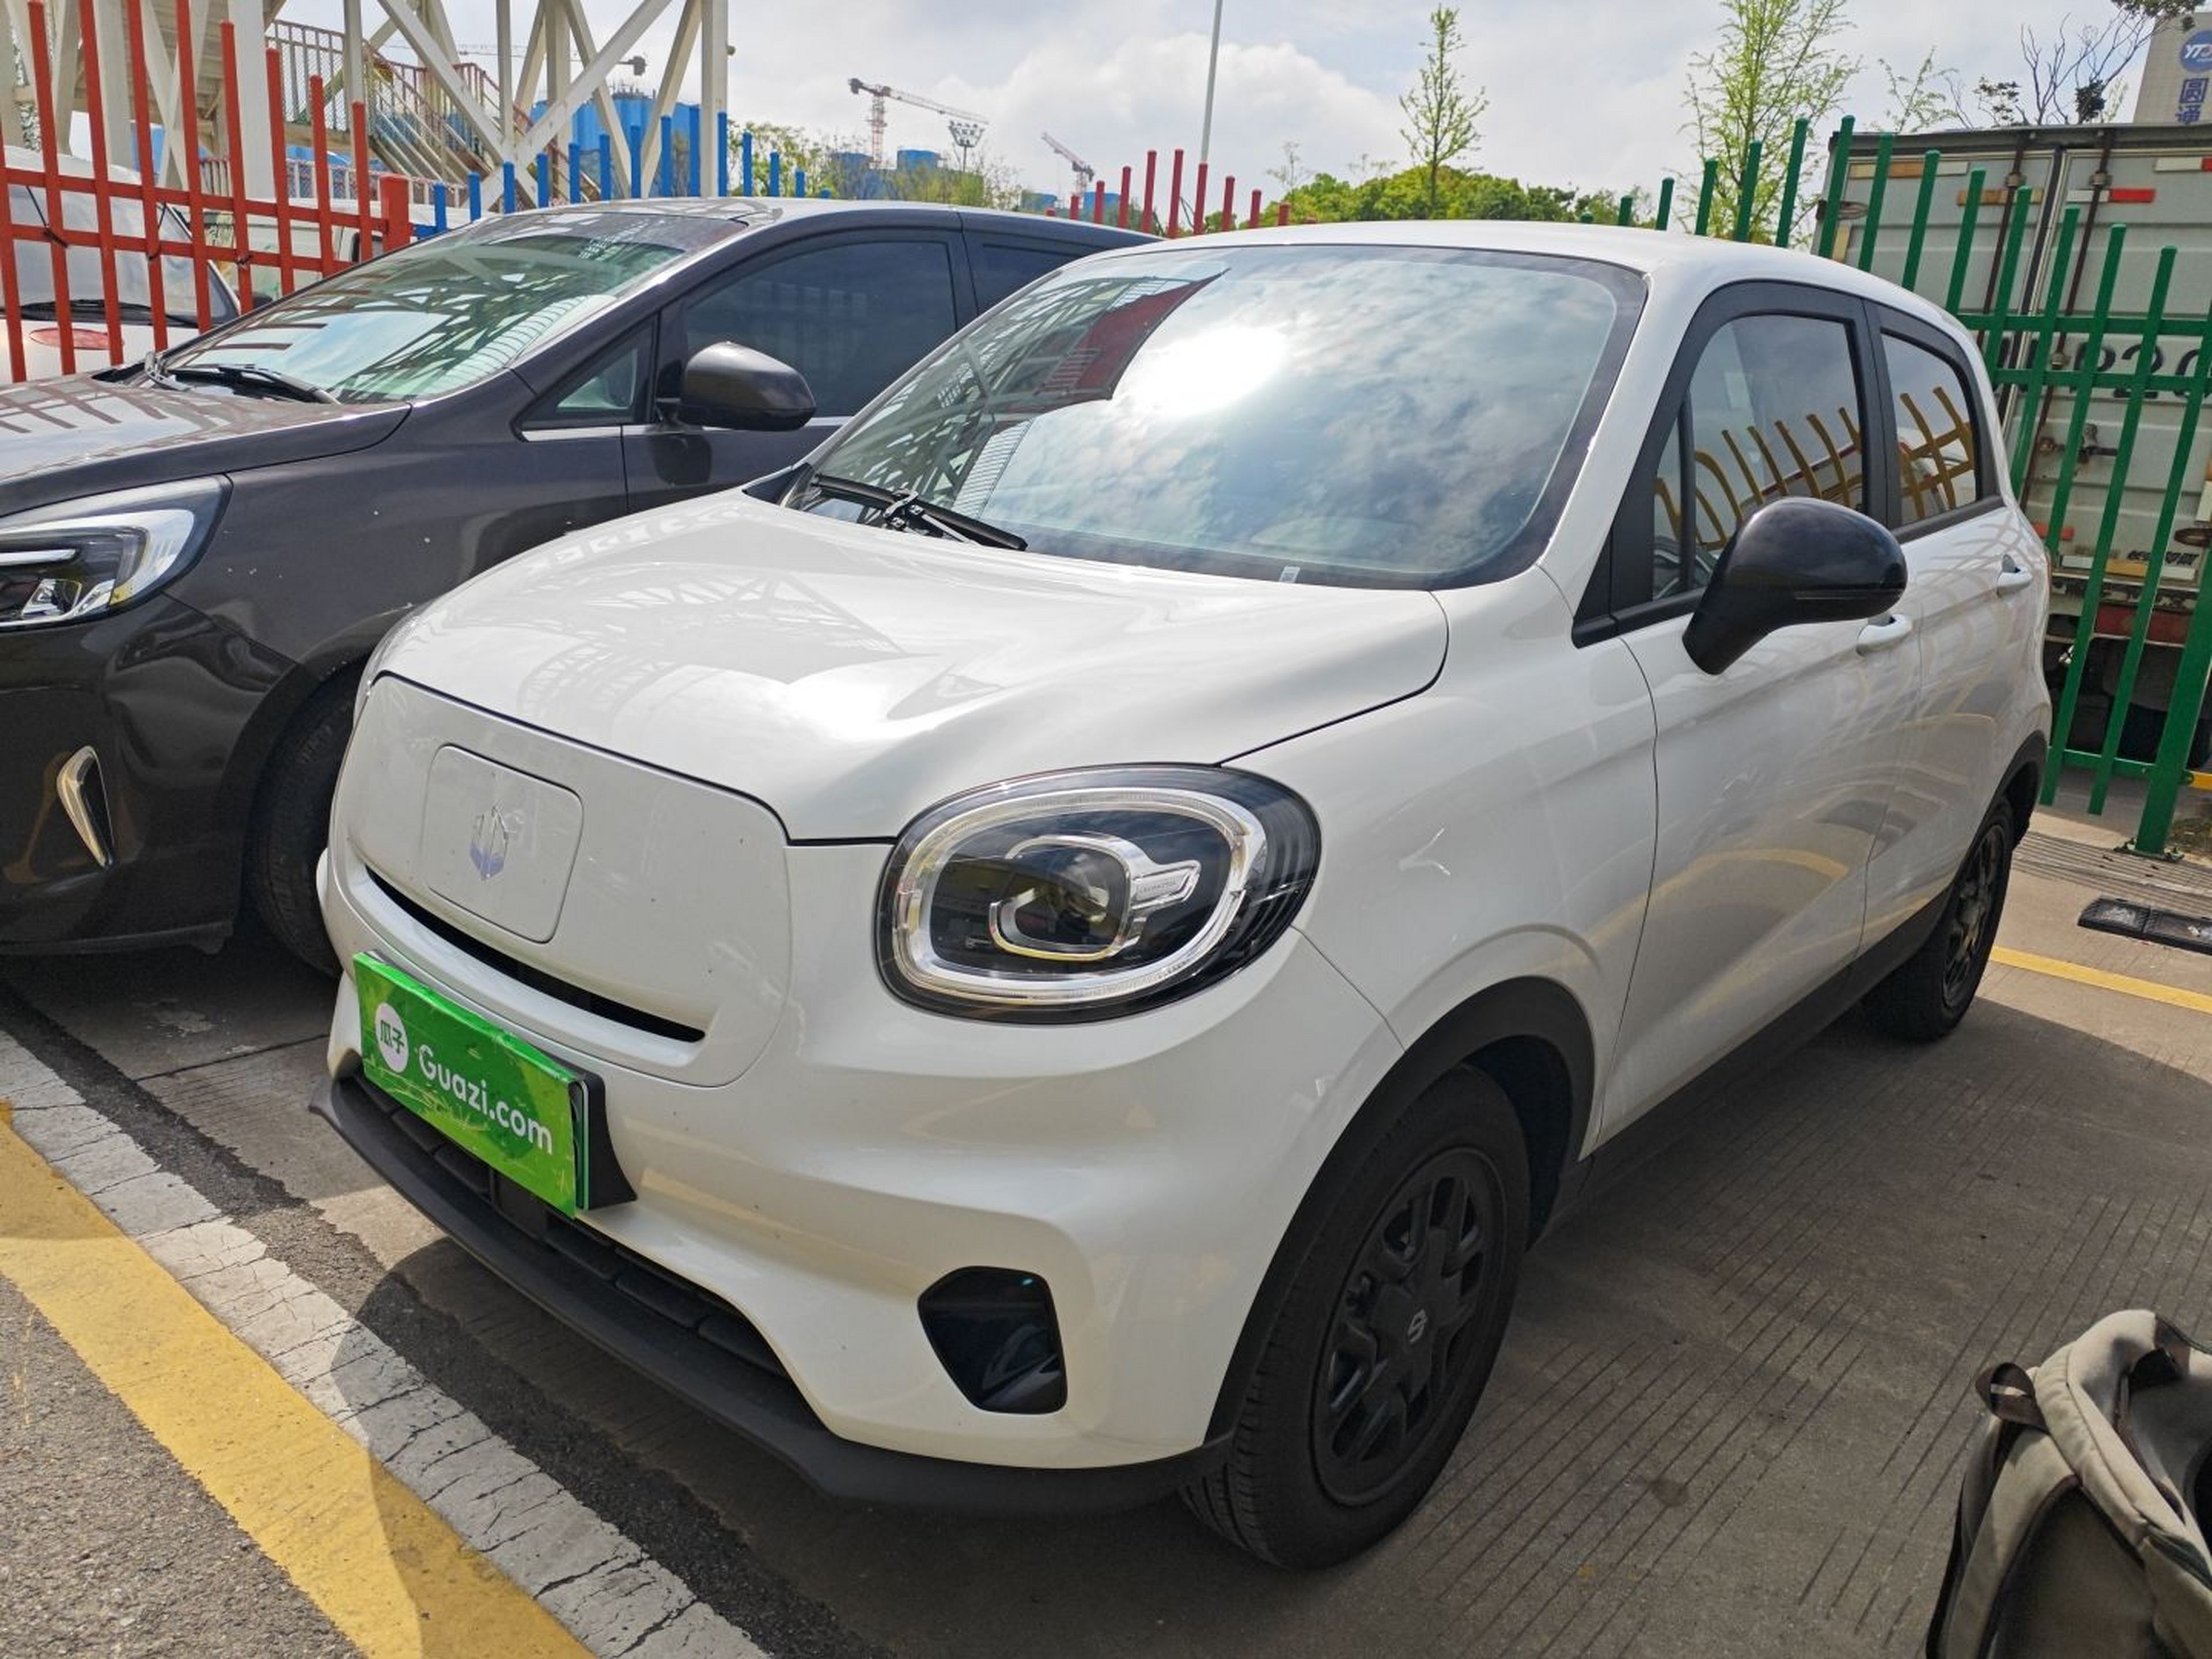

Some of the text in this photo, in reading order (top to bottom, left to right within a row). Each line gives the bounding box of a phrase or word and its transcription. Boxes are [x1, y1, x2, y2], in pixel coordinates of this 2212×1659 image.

[2185, 44, 2212, 58] YT
[380, 1019, 404, 1055] 瓜子
[419, 1044, 552, 1155] Guazi.com
